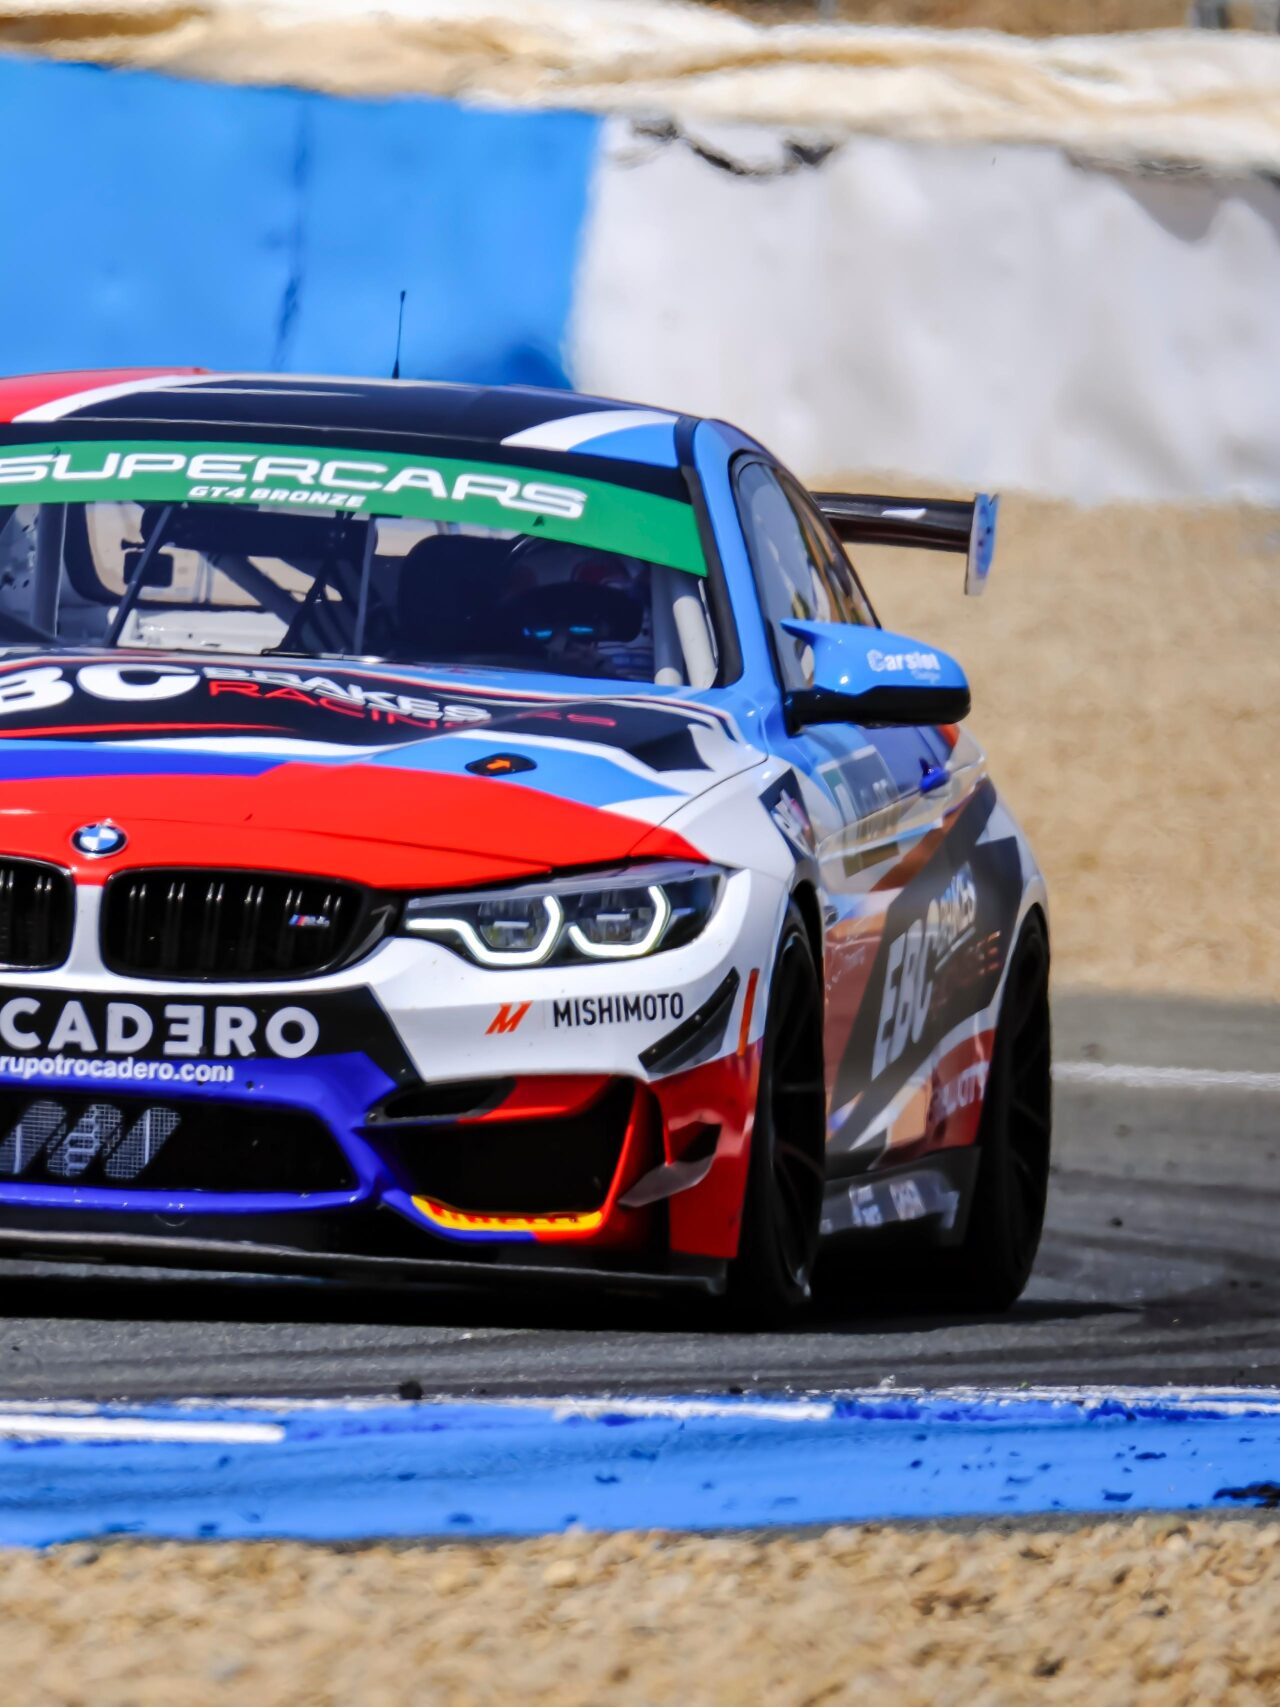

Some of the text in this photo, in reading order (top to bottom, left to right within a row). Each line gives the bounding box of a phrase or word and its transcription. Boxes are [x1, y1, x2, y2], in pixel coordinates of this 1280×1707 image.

[188, 485, 367, 509] GT4 BRONZE
[202, 667, 493, 723] BRAKES
[553, 992, 685, 1028] MISHIMOTO
